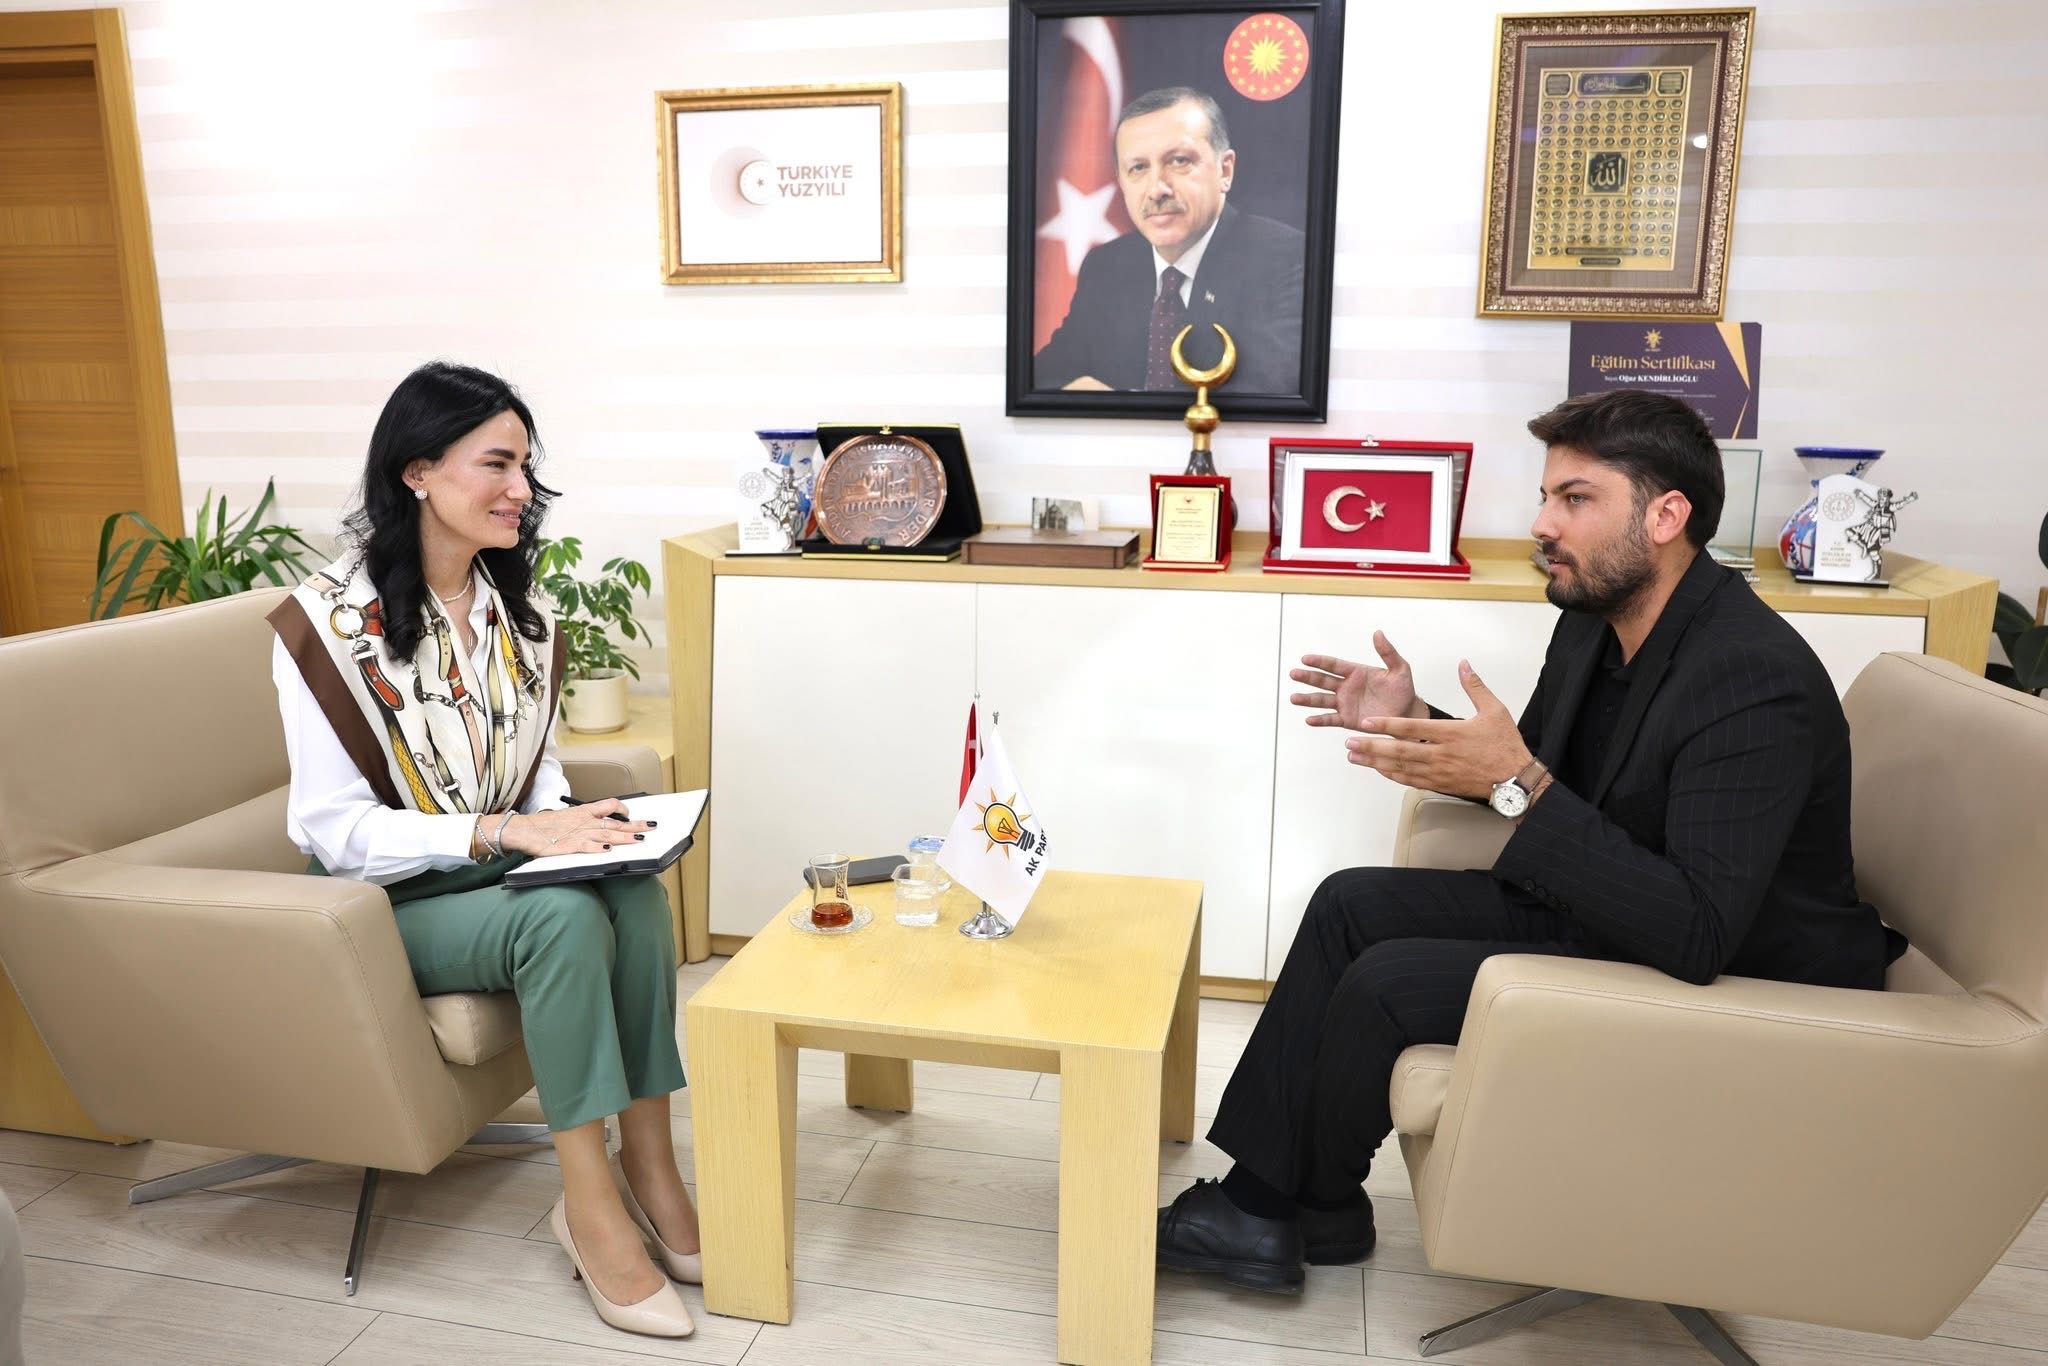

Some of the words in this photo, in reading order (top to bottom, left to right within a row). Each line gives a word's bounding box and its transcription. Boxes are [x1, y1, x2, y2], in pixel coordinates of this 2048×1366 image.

[1591, 354, 1638, 372] Eğitim
[1640, 354, 1716, 370] Sertifikası
[898, 513, 928, 541] DER
[1025, 857, 1040, 876] AK
[1034, 828, 1048, 857] PAR
